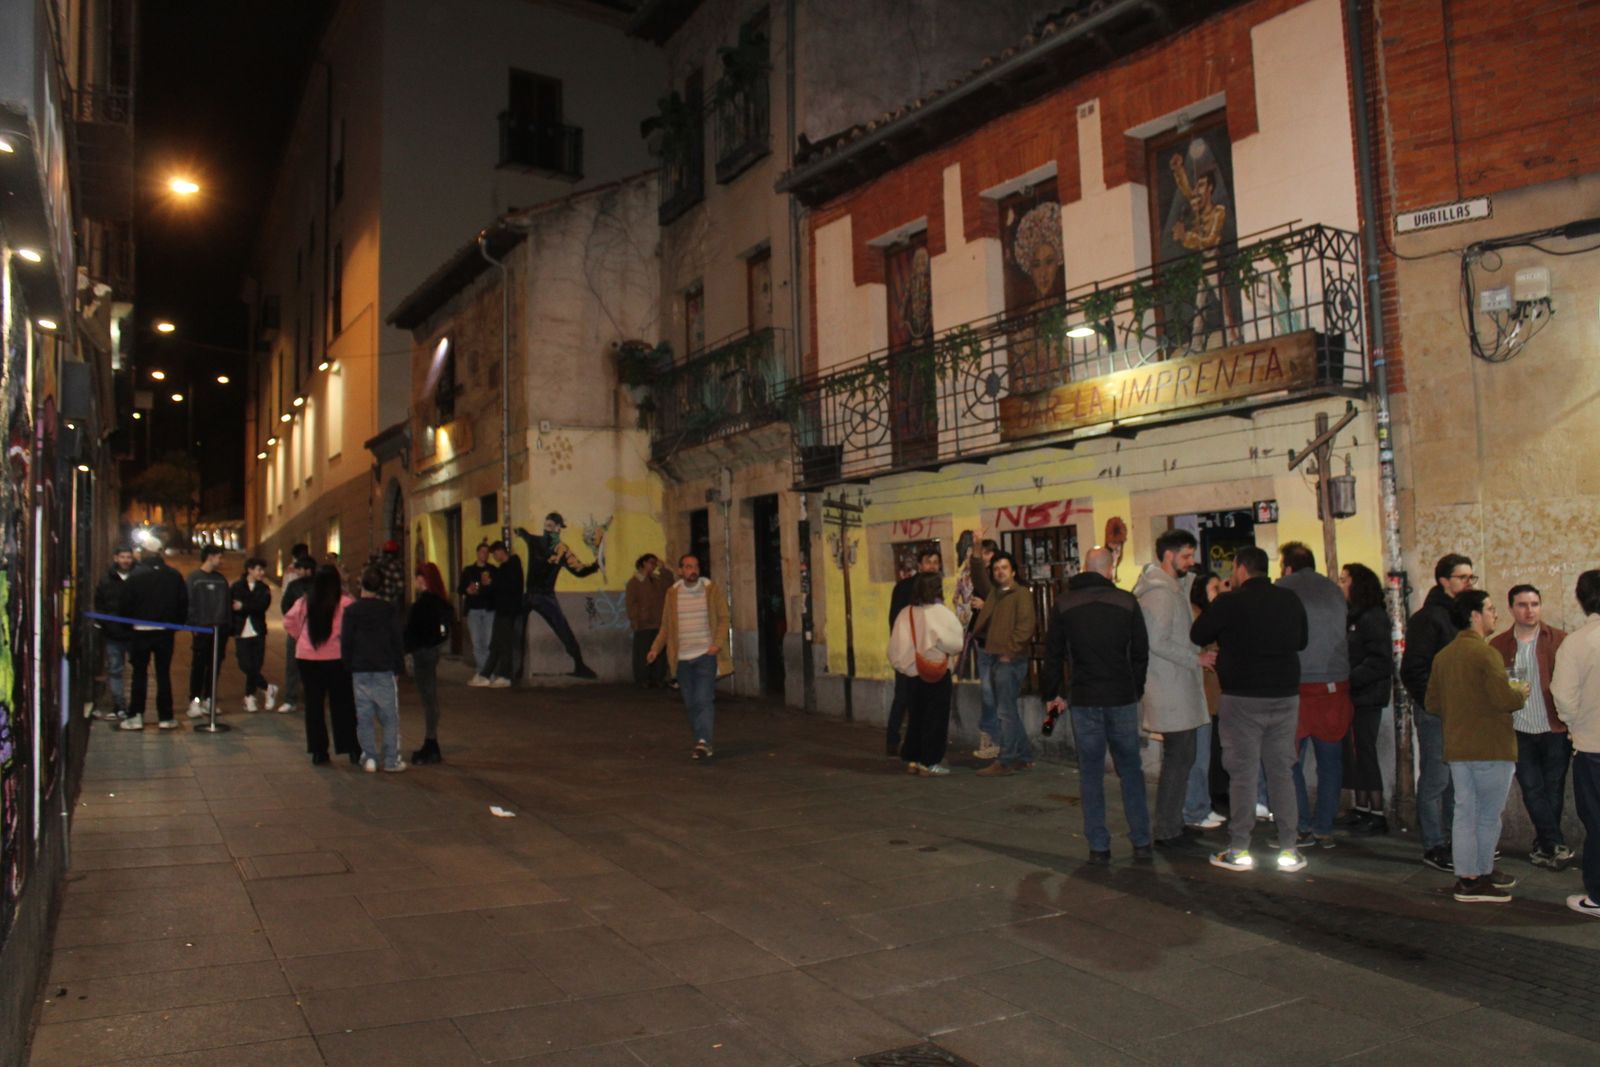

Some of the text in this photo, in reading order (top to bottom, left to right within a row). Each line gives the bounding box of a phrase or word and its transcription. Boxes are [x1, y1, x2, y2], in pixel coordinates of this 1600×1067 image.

[1414, 204, 1471, 226] VARILLAS
[1019, 349, 1283, 428] BAR LA IMPRENTA
